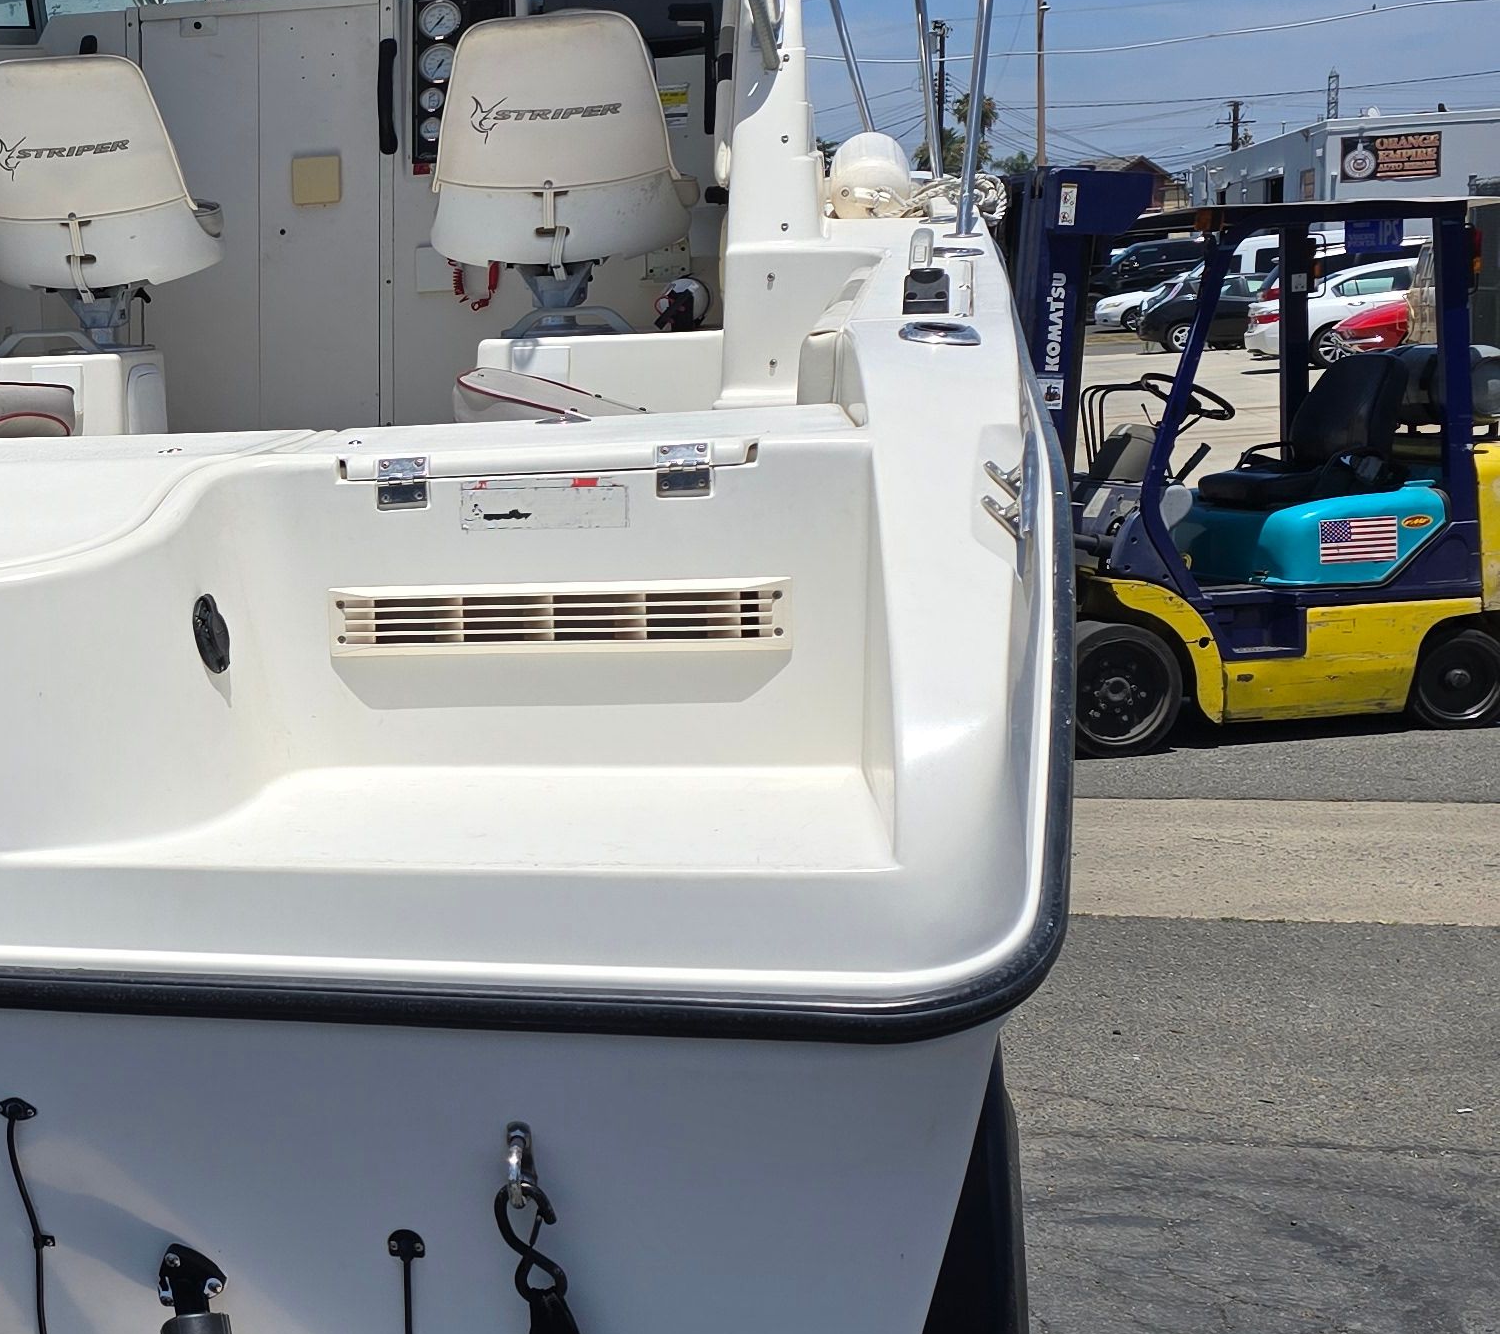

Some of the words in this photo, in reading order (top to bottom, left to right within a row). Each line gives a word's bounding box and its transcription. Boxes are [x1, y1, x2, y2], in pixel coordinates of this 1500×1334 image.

[493, 103, 622, 120] STRIPER
[16, 139, 130, 158] STRIPER
[1375, 134, 1439, 149] ORANGE
[1378, 148, 1437, 162] EMPIRE
[1044, 272, 1067, 371] KOMATSU
